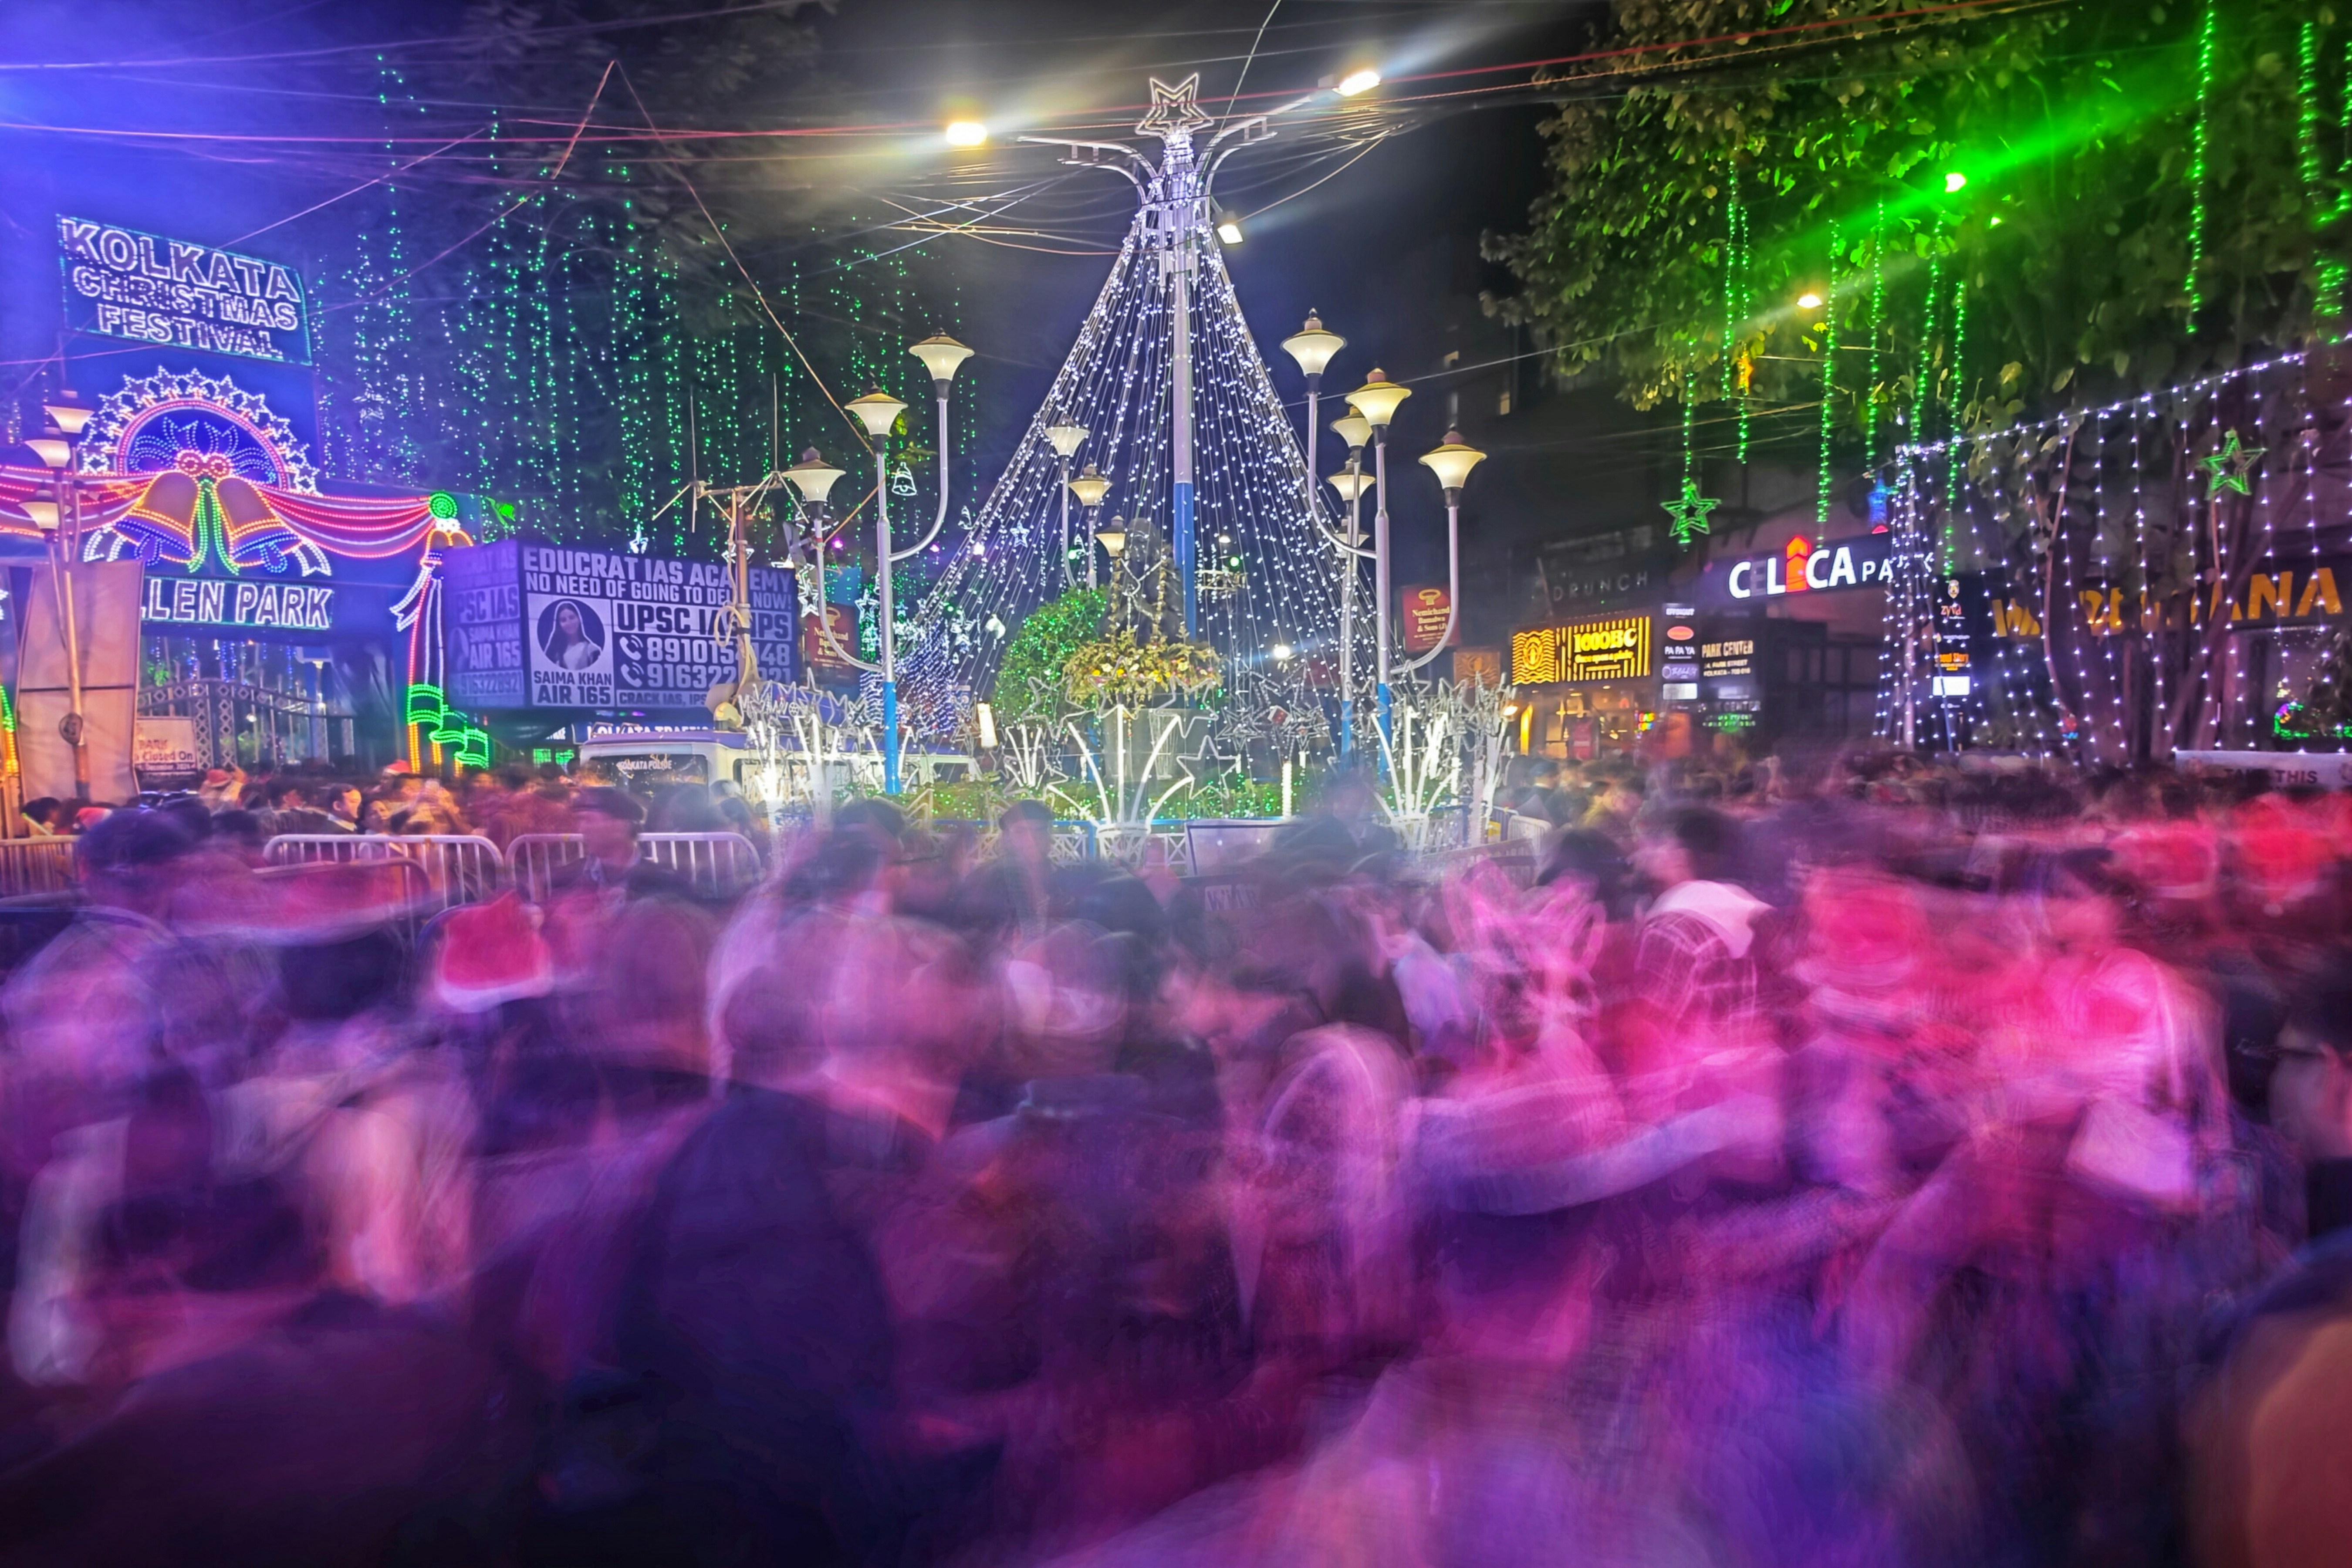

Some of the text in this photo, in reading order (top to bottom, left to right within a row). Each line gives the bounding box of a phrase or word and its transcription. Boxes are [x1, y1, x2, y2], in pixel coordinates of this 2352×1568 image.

[61, 218, 301, 303] KOLKATA
[73, 265, 298, 331] CHRISTMAS
[97, 303, 284, 359] FESTIVAL
[524, 547, 791, 592] EDUCRAT IAS ACAEMY
[1729, 535, 1856, 598] CELICA
[141, 579, 333, 629] LEN PARK
[491, 586, 519, 620] IAS
[526, 571, 550, 592] NO
[556, 574, 601, 596] NEED
[606, 579, 627, 598] OF
[631, 581, 679, 602] GOING
[683, 585, 703, 604] TO
[707, 588, 741, 605] DEL
[753, 591, 792, 610] NOW!
[616, 602, 691, 635] UPSC
[470, 641, 520, 670] AIR 165
[647, 637, 790, 666] 891015148
[1702, 640, 1754, 658] PARK CENTER
[534, 670, 612, 686] SAIMA KHAN
[648, 663, 791, 689] 916322921
[537, 684, 611, 705] AIR 165
[619, 692, 660, 705] CRACK
[179, 750, 193, 761] On
[2275, 770, 2318, 784] THIS
